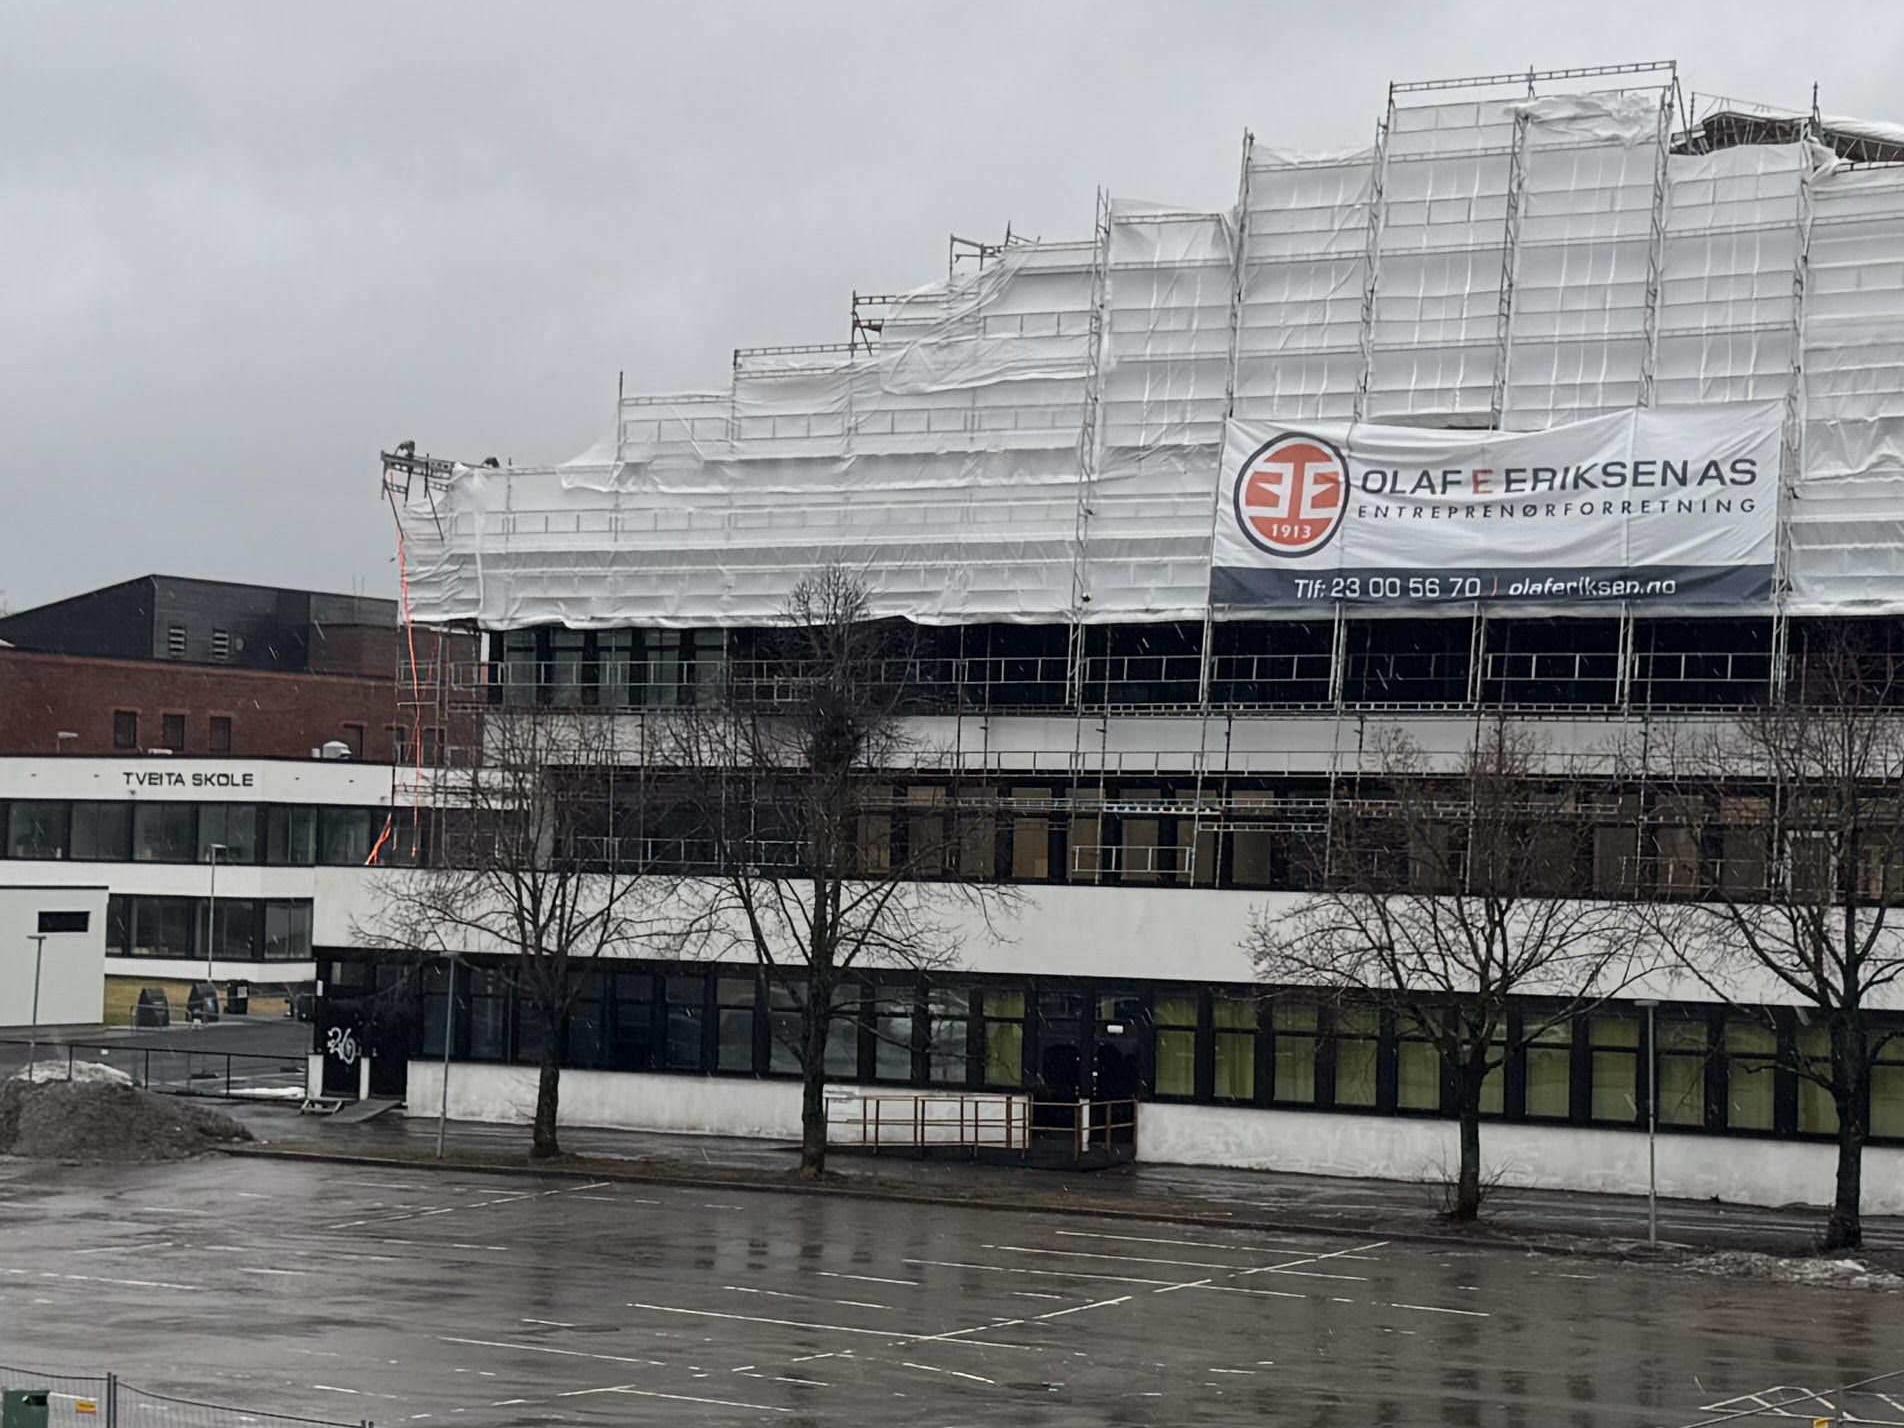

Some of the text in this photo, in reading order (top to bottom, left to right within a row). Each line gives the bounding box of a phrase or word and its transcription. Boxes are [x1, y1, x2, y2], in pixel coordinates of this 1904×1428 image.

[1361, 469, 1462, 495] OLAF
[1504, 459, 1688, 493] ERIKSEN
[1696, 458, 1757, 486] AS
[1358, 498, 1755, 519] ENTREPRENØRFORRETNING
[1272, 524, 1311, 538] 1913
[1295, 577, 1480, 598] Tlf: 23 00 56 70
[1509, 576, 1676, 596] olaferiksen.no
[123, 771, 254, 787] TVEITA SKOLE
